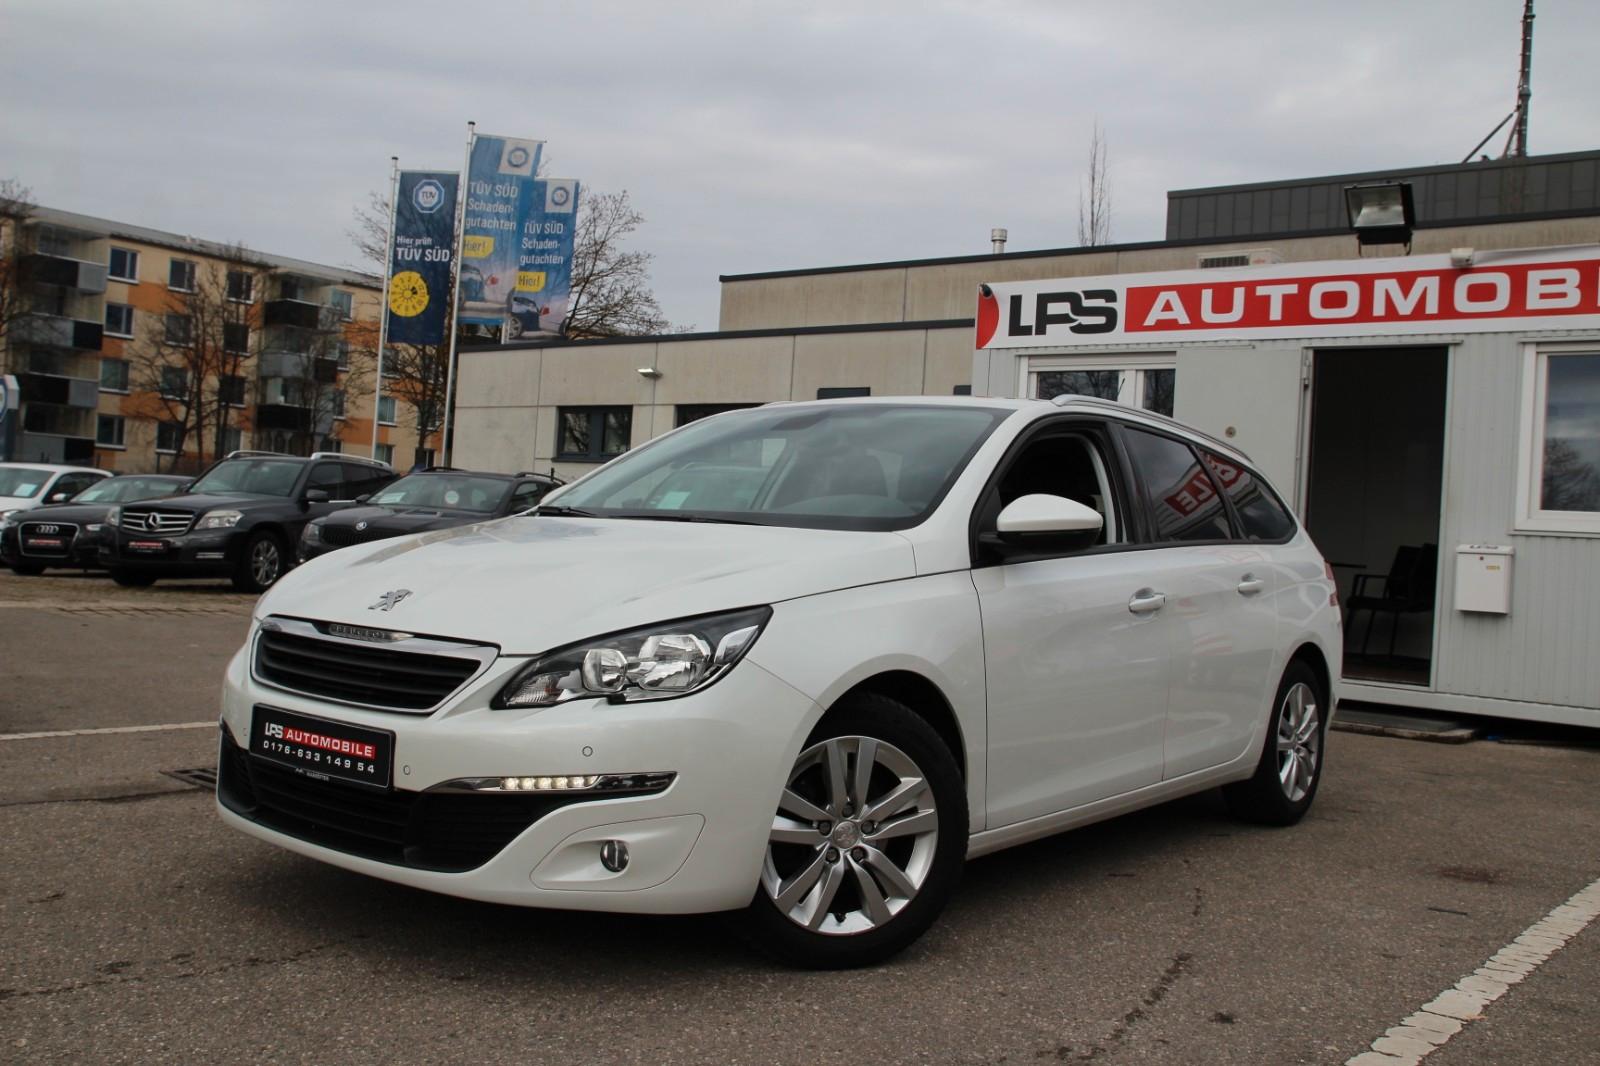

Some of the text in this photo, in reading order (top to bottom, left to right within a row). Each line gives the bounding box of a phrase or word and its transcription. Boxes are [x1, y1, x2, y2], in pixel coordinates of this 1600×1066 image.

[469, 181, 518, 198] TÜV SÜD
[467, 199, 515, 214] Schaden-
[464, 217, 516, 231] gutachten
[524, 220, 564, 235] TÜV SÜD
[396, 236, 414, 245] Hier
[522, 237, 561, 250] Schaden-
[396, 245, 450, 263] TÜV SÜD
[520, 253, 564, 266] gutachten
[519, 273, 541, 288] Hier!
[1008, 267, 1600, 338] LPS AUTOMOB
[285, 728, 373, 757] AUTOMOBILE
[263, 740, 375, 774] 0176-633 149 54
